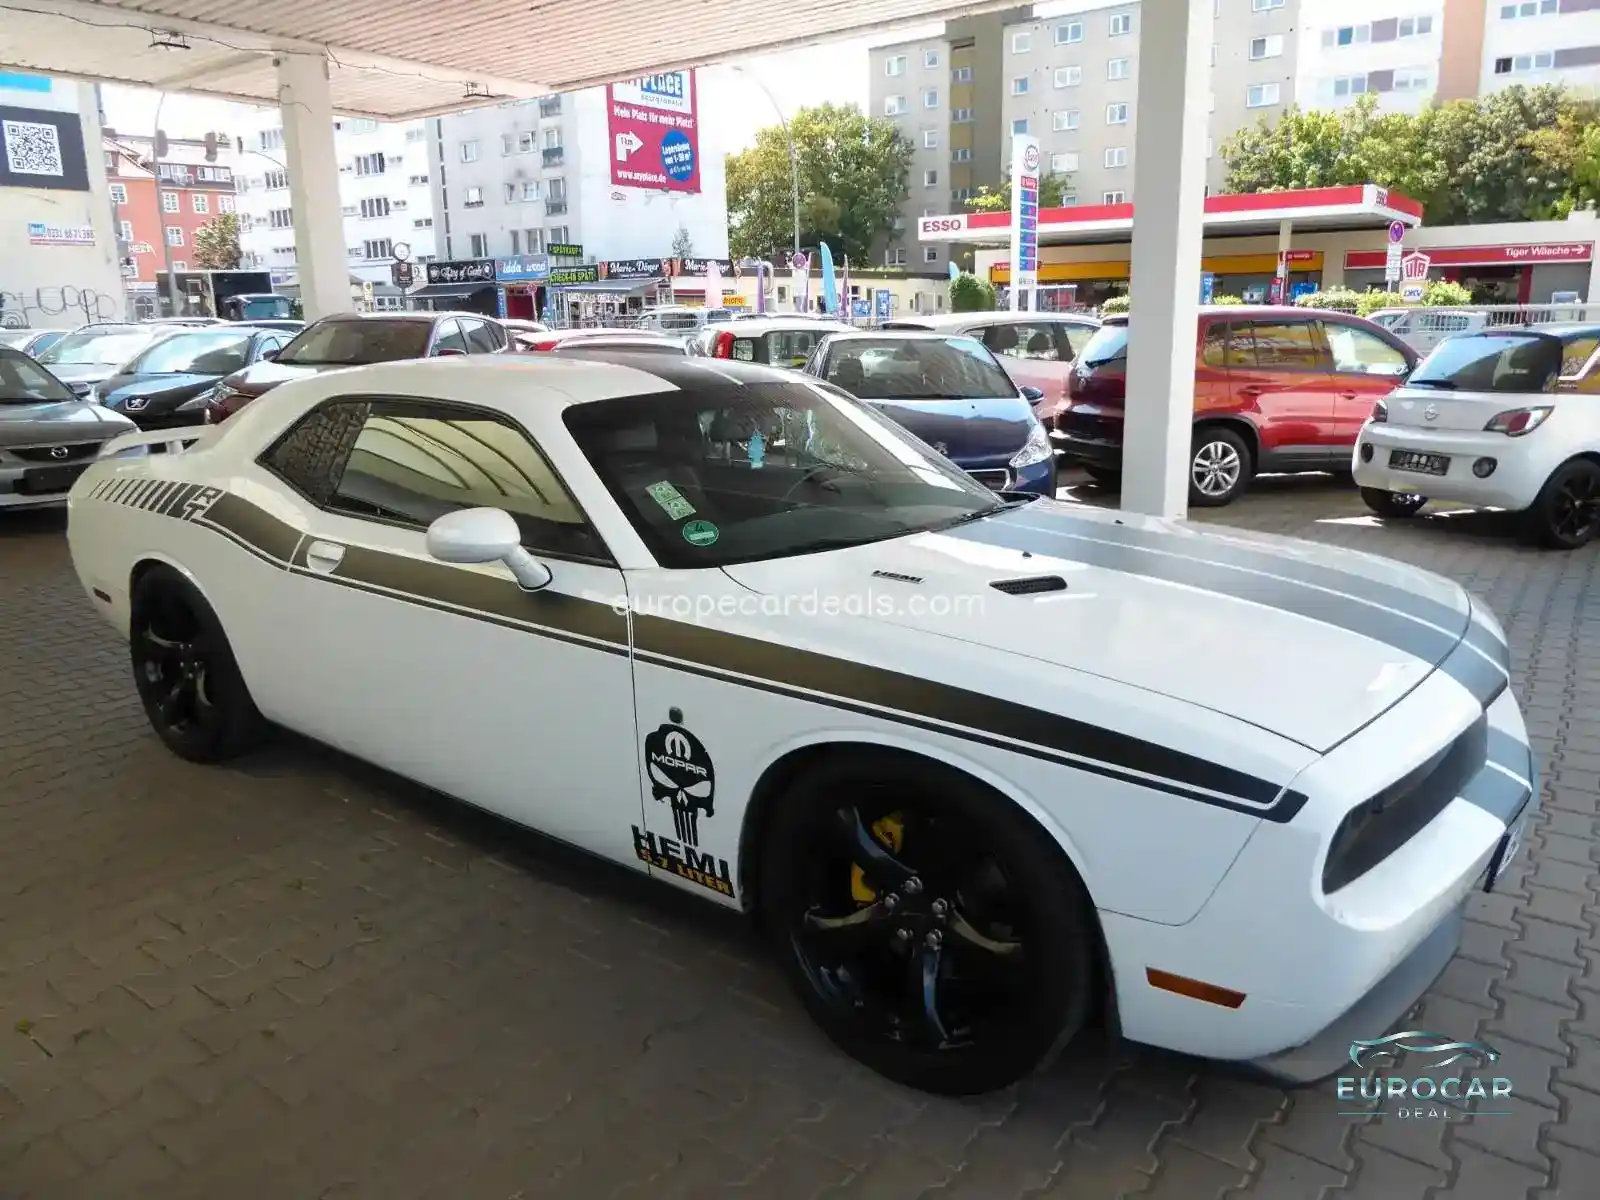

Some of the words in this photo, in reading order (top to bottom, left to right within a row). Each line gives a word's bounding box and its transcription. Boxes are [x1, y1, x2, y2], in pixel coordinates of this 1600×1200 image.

[631, 108, 648, 121] Platz
[922, 218, 962, 233] ESSO
[1504, 247, 1529, 258] Tiger
[637, 260, 659, 273] Döner
[872, 569, 925, 584] HEMI
[651, 751, 708, 778] MOPAR
[630, 823, 731, 880] HEMI
